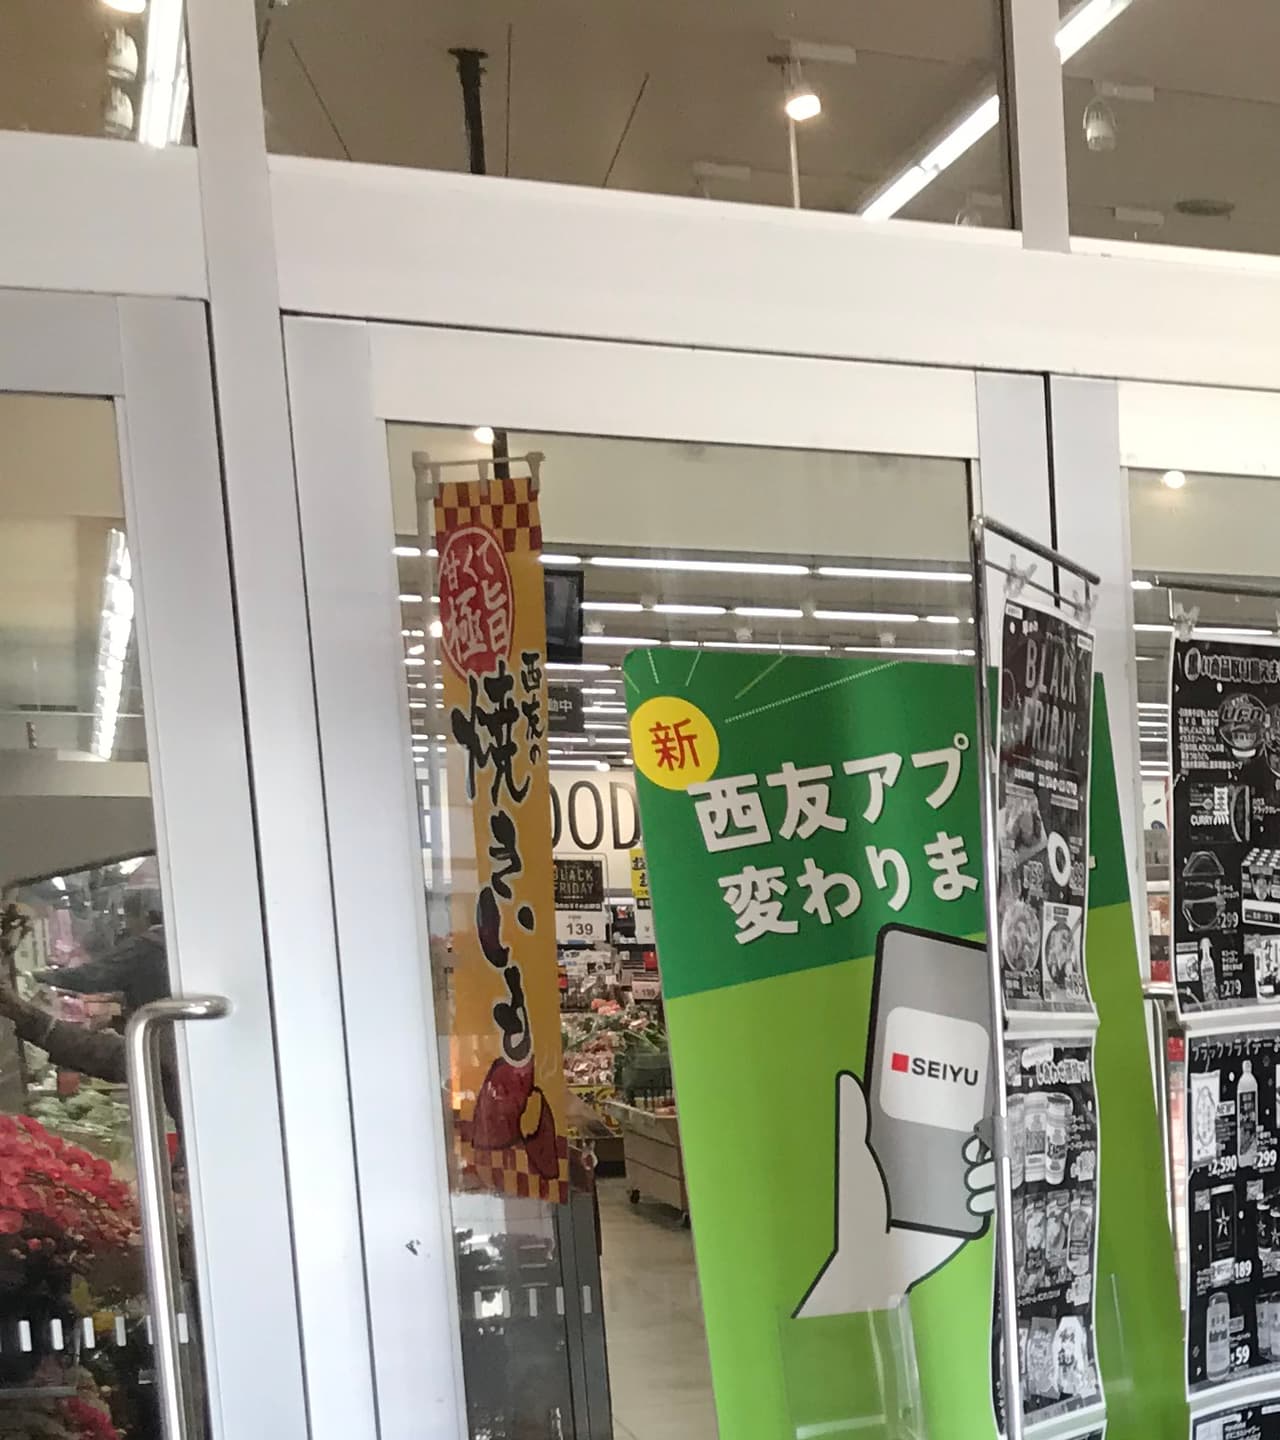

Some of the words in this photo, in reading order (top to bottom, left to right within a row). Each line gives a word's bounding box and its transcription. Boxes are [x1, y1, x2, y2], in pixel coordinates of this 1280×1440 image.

[443, 537, 495, 590] 甘くて
[447, 580, 509, 663] 極旨
[1025, 637, 1078, 705] BLACK
[649, 718, 702, 772] 新
[1022, 696, 1077, 759] FRIDAY
[687, 732, 971, 854] 西友アプ
[718, 830, 980, 946] 変わりま
[565, 922, 594, 936] 139
[1220, 911, 1239, 930] 299
[1222, 979, 1242, 998] 279
[911, 1056, 979, 1086] SEIYU
[1257, 1149, 1278, 1168] 299
[1234, 1260, 1253, 1279] 189
[1235, 1345, 1250, 1365] 59
